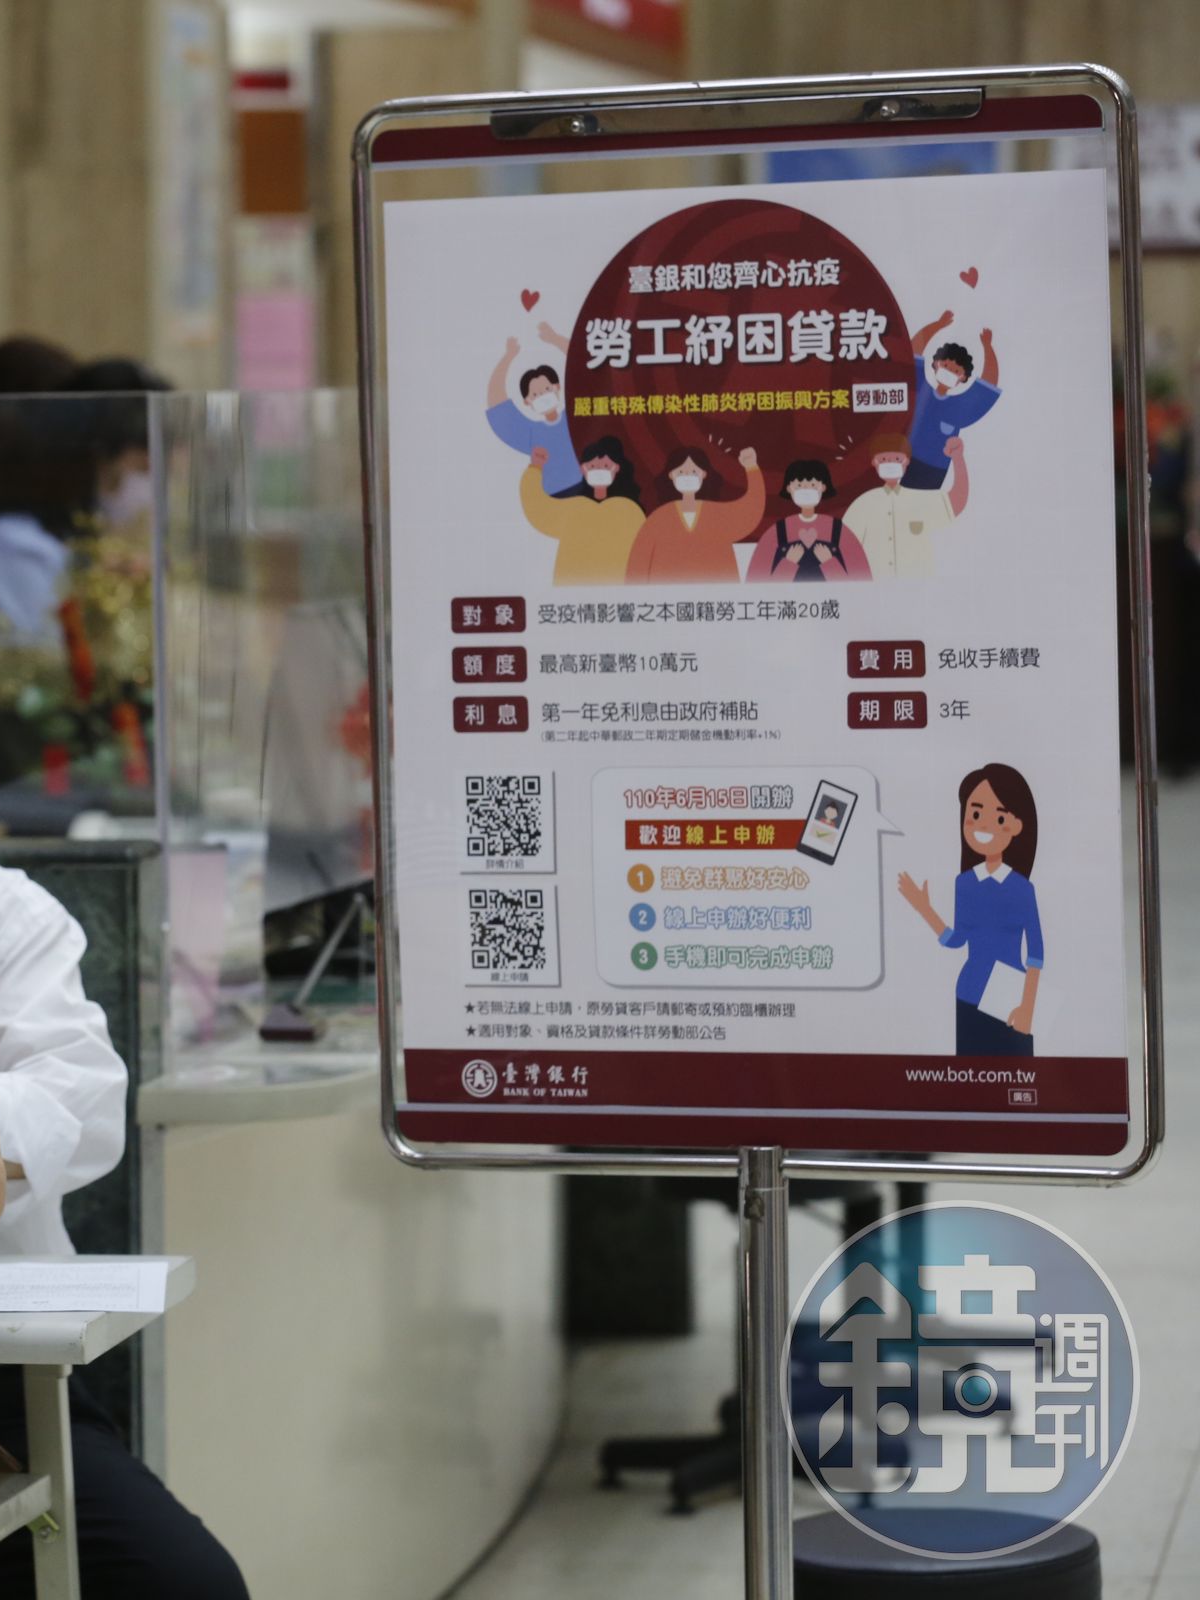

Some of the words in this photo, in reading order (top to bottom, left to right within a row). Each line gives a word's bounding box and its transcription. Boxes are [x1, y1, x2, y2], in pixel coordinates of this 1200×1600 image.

[628, 257, 841, 295] 臺銀和您齊心抗疫
[584, 308, 889, 371] 勞工紓困貸款
[573, 390, 850, 417] 嚴重特殊傳染性肺炎紓困振興方案
[855, 388, 905, 408] 勞動部
[462, 604, 515, 627] 對象
[537, 600, 841, 624] 受疫情影響之本國籍勞工年滿20歲
[462, 653, 516, 676] 額度
[538, 651, 699, 675] 最高新臺幣10萬元
[858, 648, 914, 671] 費用
[938, 647, 1041, 669] 免收手續費
[464, 703, 518, 726] 利息
[541, 700, 759, 723] 第一年免利息由政府補貼
[859, 699, 915, 722] 期限
[939, 699, 971, 721] 3年
[624, 785, 794, 810] 110年6月15日開辦
[638, 824, 776, 846] 歡迎線上申辦
[660, 866, 810, 891] 避免群聚好安心
[663, 906, 812, 930] 線上申辦好便利
[664, 944, 833, 969] 手機即可完成申辦
[501, 1062, 589, 1085] 臺灣銀行
[905, 1066, 1036, 1083] www.bot.com.tw
[503, 1087, 530, 1097] BANK
[532, 1087, 546, 1097] OF
[550, 1087, 588, 1098] TAIWAN
